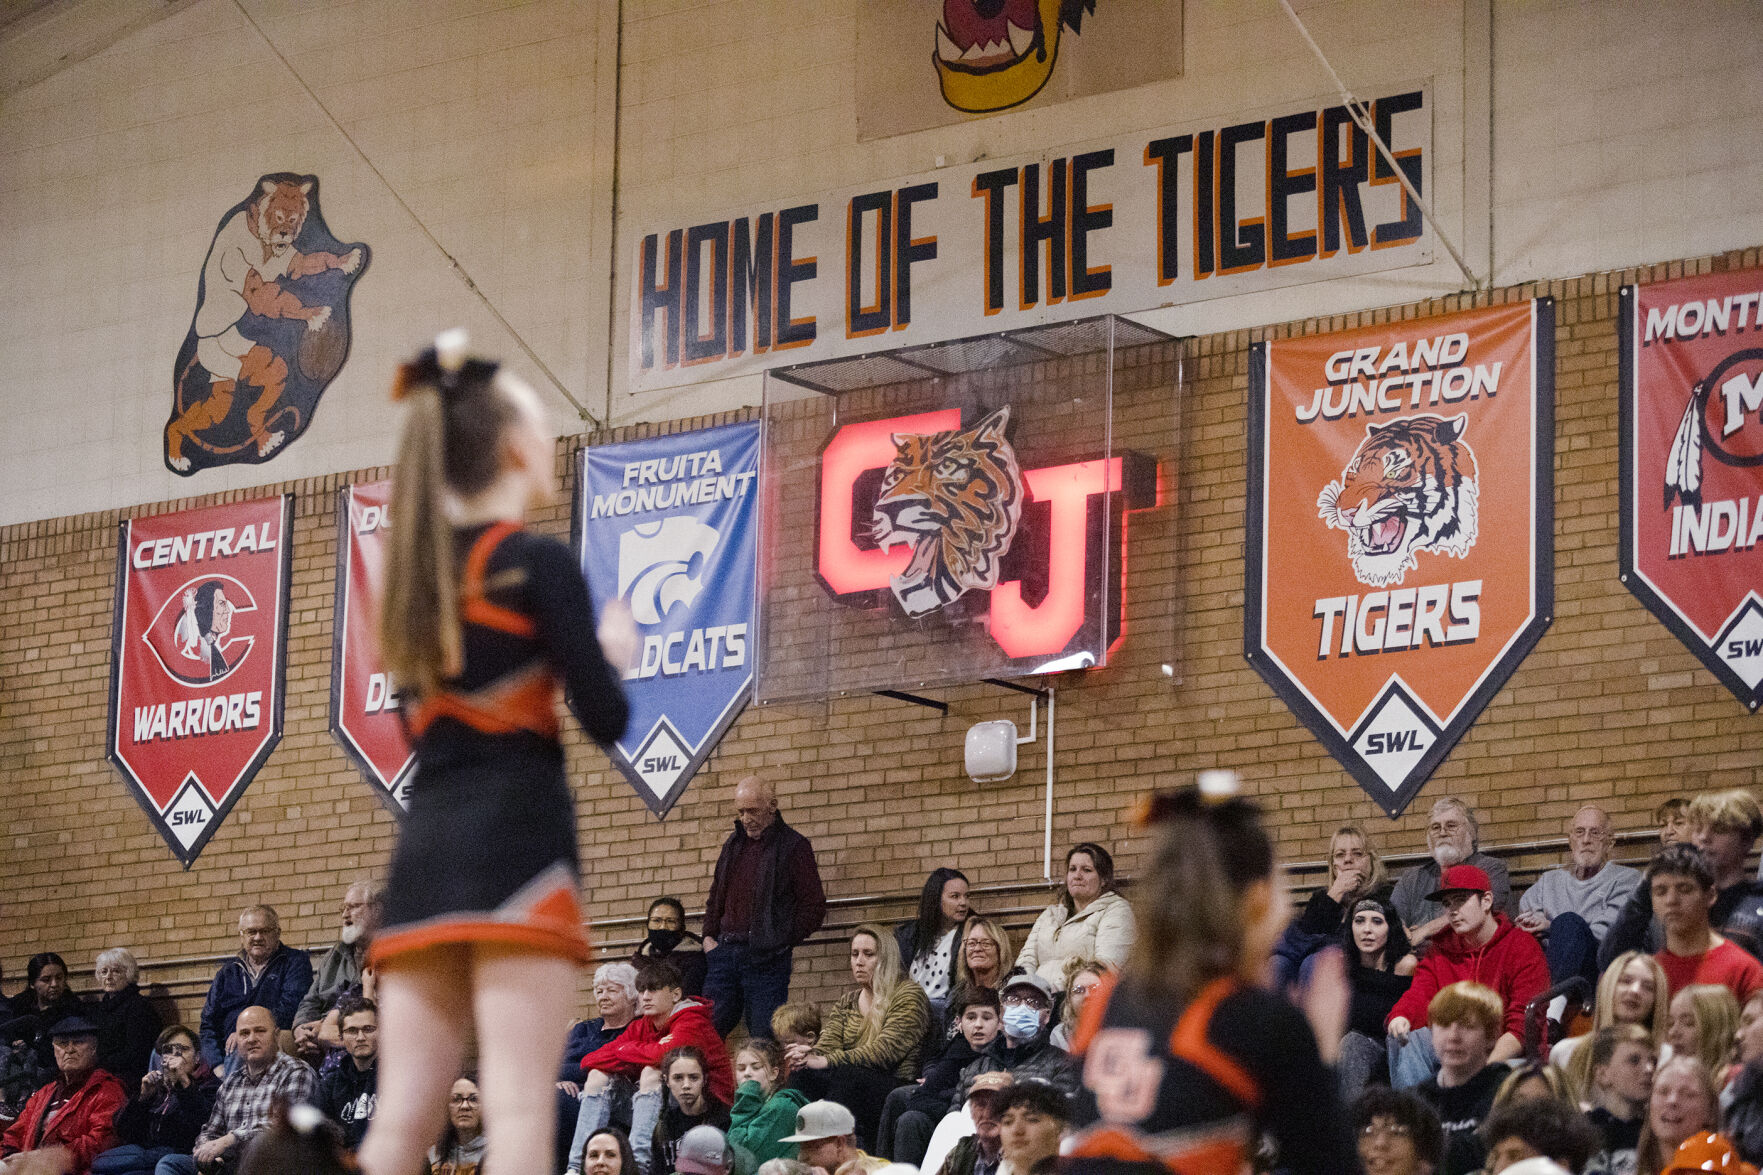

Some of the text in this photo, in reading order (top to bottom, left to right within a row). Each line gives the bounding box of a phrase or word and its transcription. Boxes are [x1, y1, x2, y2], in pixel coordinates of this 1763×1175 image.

[639, 91, 1423, 372] HOME OF THE TIGERS
[1325, 332, 1469, 382] GRAND
[1296, 363, 1502, 421] JUNCTION
[622, 450, 722, 489] FRUITA
[591, 471, 756, 519] MONUMENT
[133, 522, 277, 570] CENTRAL
[1313, 580, 1483, 658] TIGERS
[133, 691, 262, 742] WARRIORS
[642, 754, 682, 774] SWL
[1364, 730, 1424, 756] SWL
[172, 809, 206, 826] SWL
